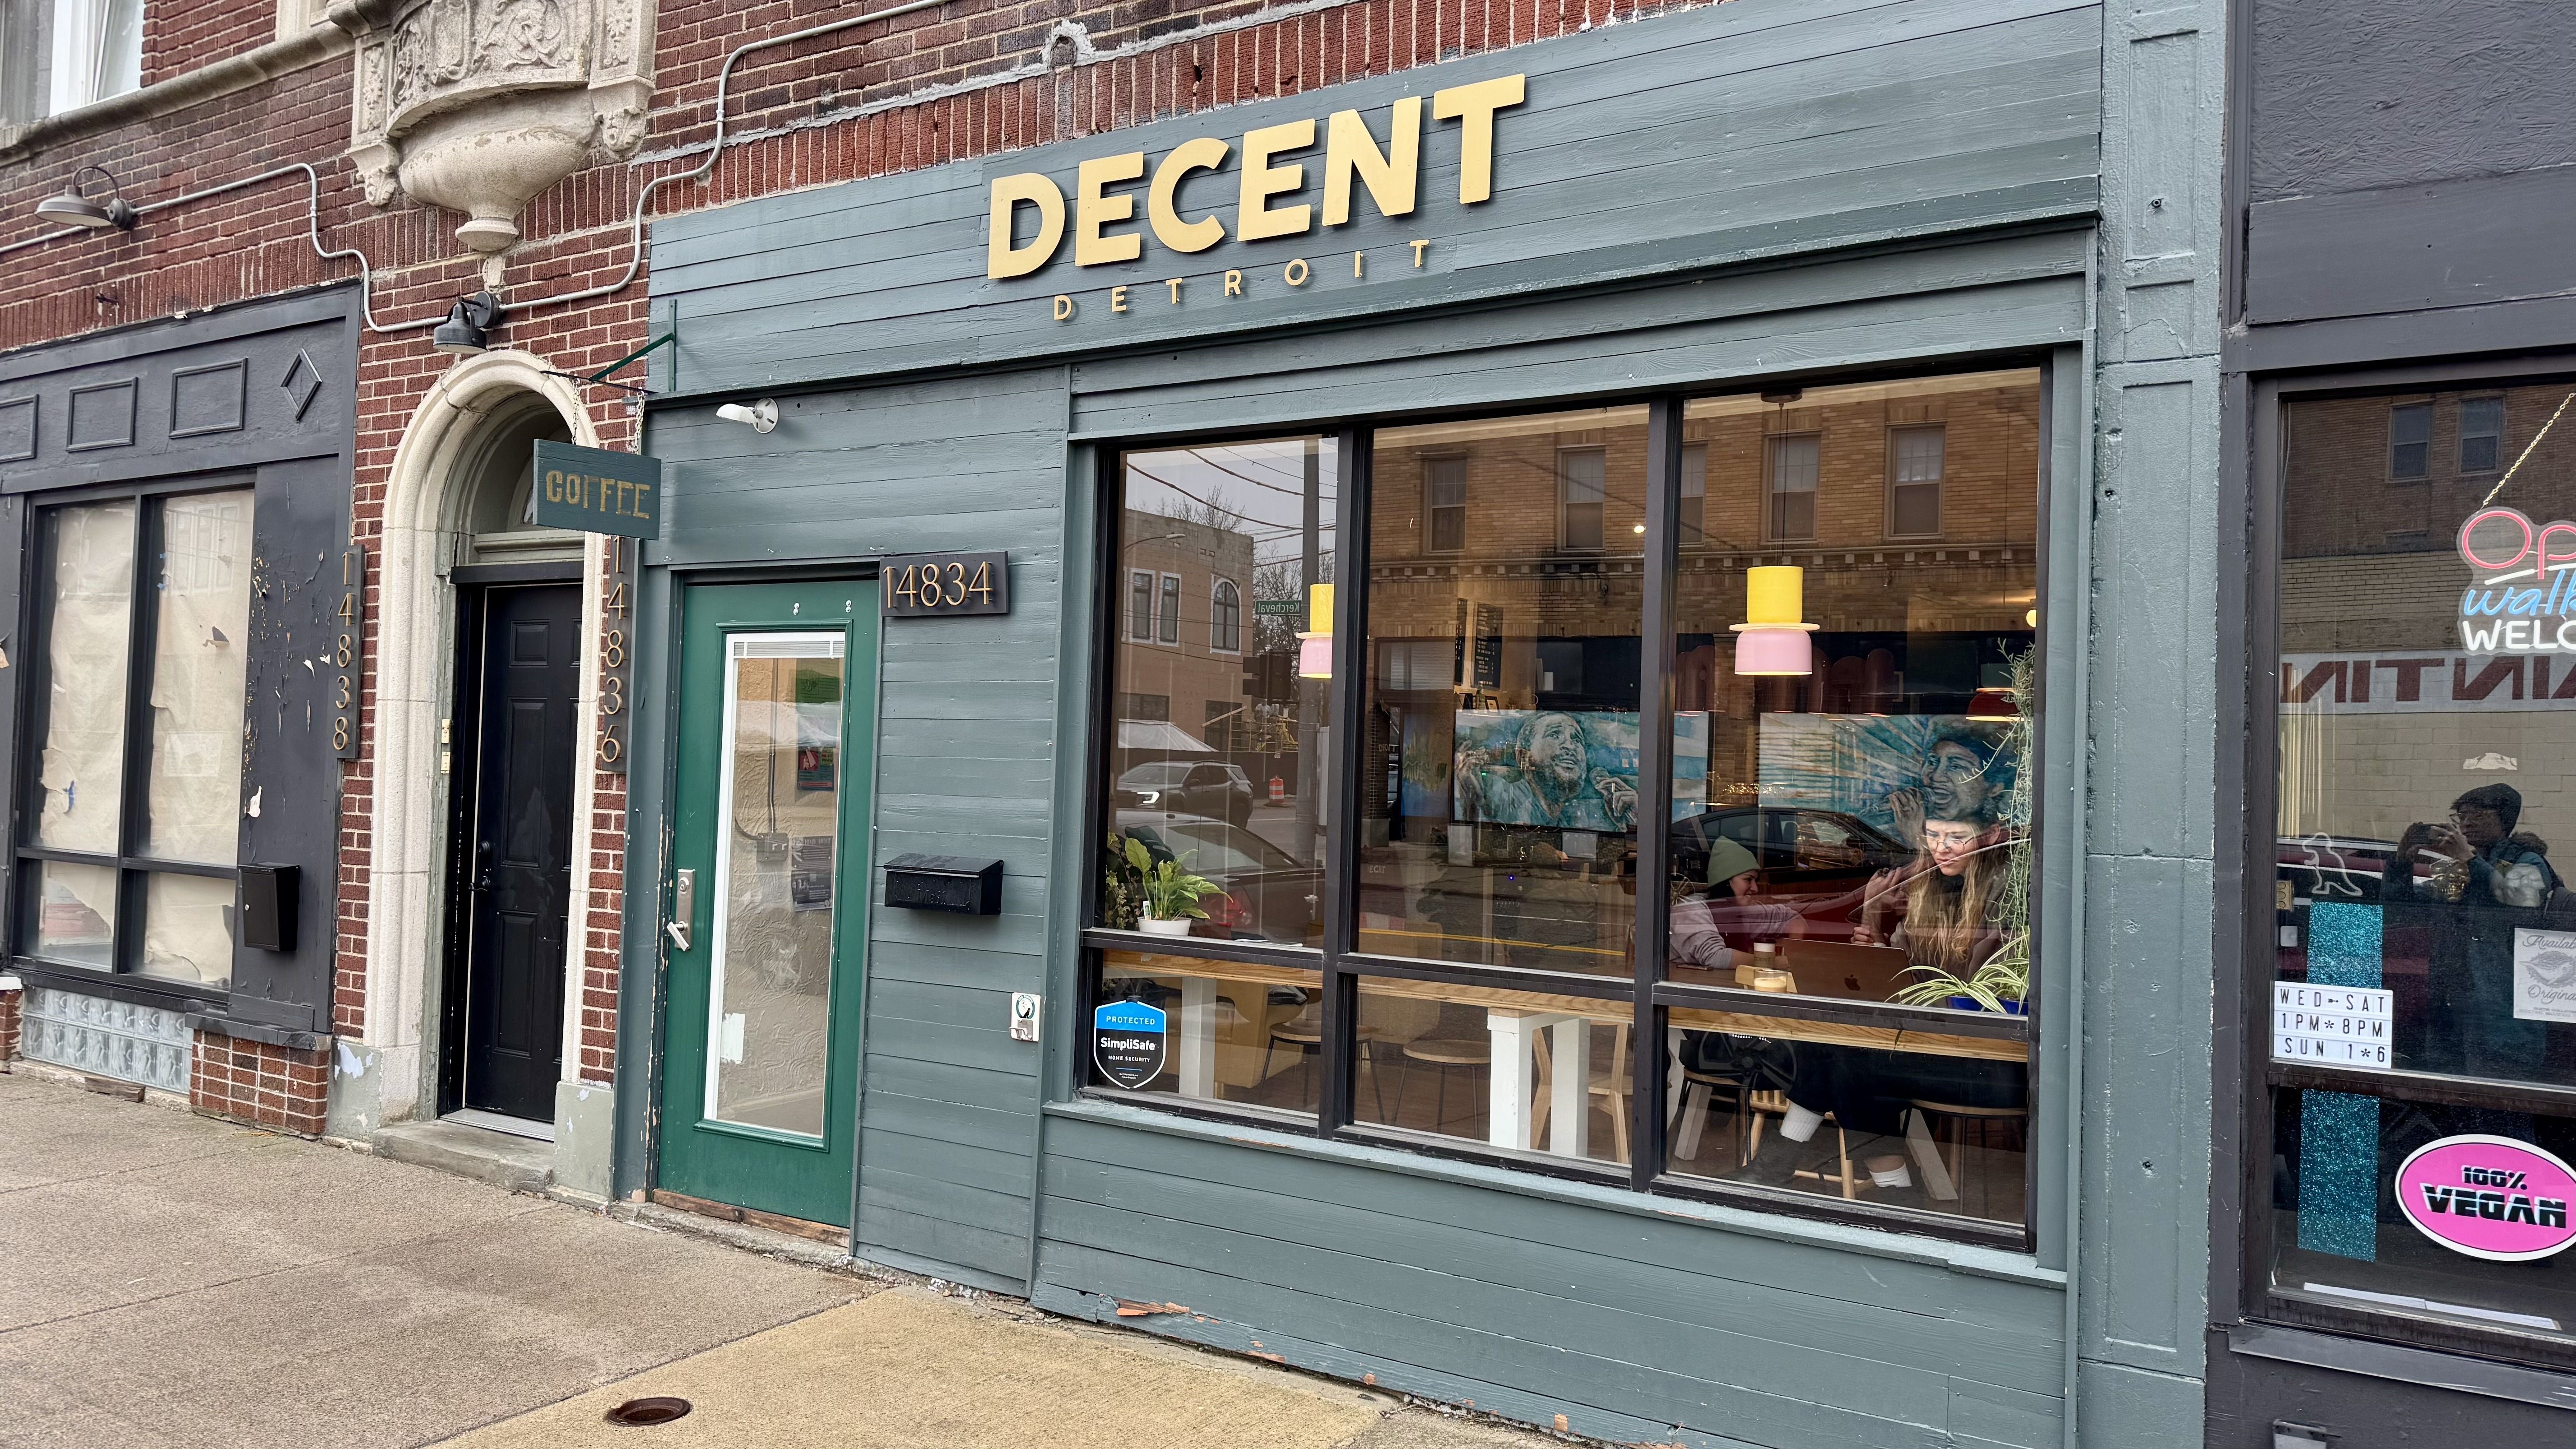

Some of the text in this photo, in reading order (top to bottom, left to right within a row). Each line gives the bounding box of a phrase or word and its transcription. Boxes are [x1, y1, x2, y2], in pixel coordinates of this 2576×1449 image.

[987, 73, 1525, 279] DECENT
[1054, 239, 1429, 320] DETROIT
[546, 470, 650, 519] COFFEE
[2462, 511, 2576, 580] Op
[883, 561, 993, 608] 14834
[333, 552, 353, 750] 14838
[601, 535, 624, 762] 14836
[1106, 1015, 1155, 1025] PROTECTED
[2280, 989, 2384, 1012] WED SAT
[1100, 1037, 1156, 1051] SimpliSafe
[2284, 1037, 2324, 1056] SUN
[2461, 1165, 2528, 1190] 100%
[2420, 1183, 2567, 1229] VEGAN
